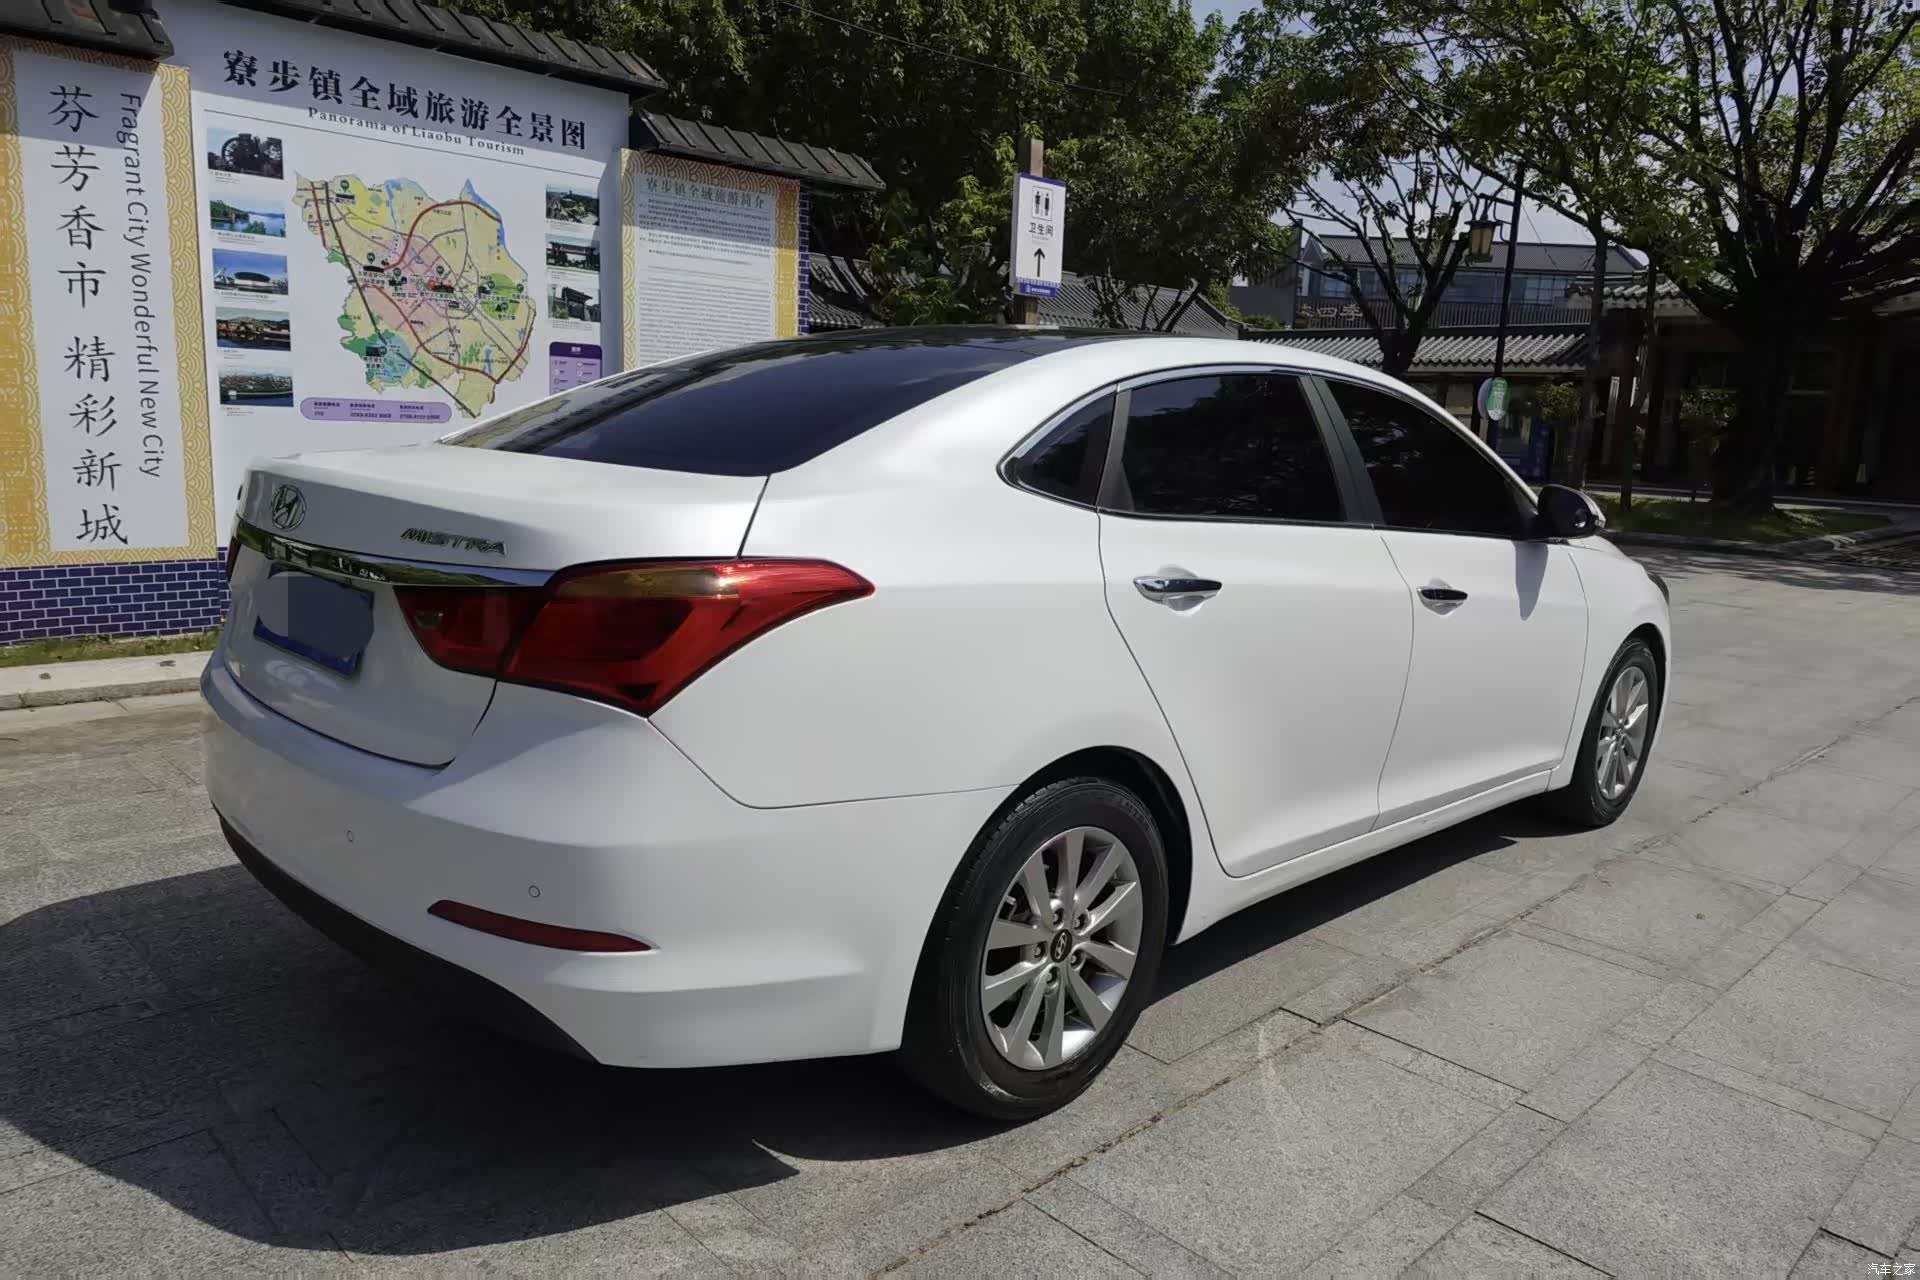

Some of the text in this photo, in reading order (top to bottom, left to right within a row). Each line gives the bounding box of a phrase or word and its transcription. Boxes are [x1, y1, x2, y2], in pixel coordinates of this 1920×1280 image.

[223, 49, 587, 151] 寮步镇全域旅游全景图
[308, 106, 526, 157] Panorama of Liaobu Tourism
[1028, 222, 1054, 238] 卫生间
[47, 84, 129, 545] 芬芳香市 精彩新城
[116, 92, 165, 478] Fragrant City Wonderful New City
[400, 528, 506, 555] MISTRA
